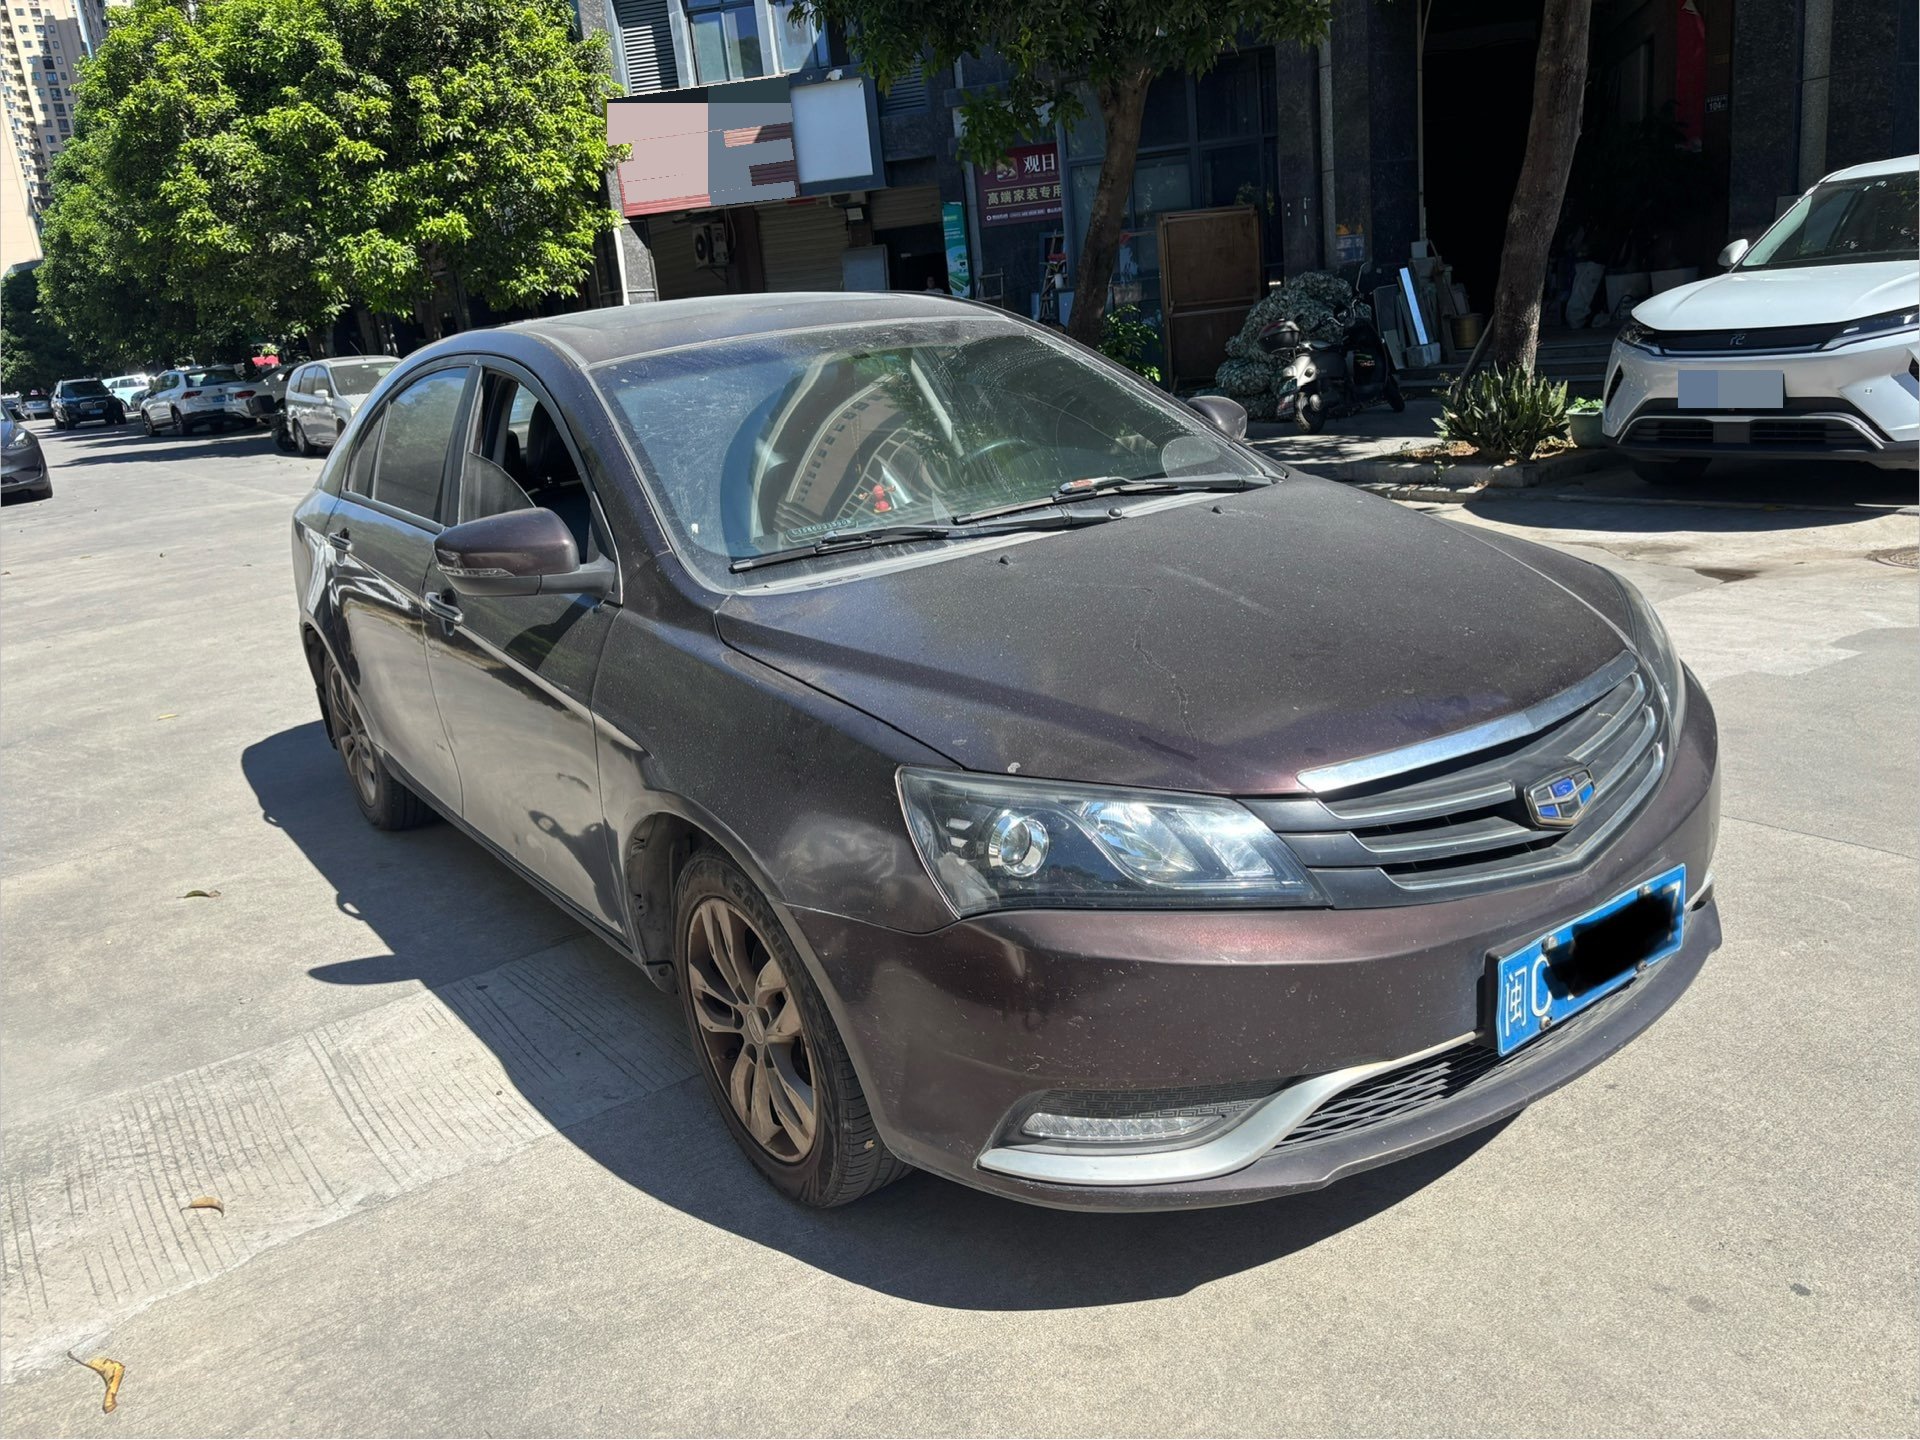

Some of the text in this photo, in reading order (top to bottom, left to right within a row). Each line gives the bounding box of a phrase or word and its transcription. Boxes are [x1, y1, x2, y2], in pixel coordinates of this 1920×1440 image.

[1023, 152, 1056, 174] 观日
[987, 184, 1063, 206] 高端家装专用
